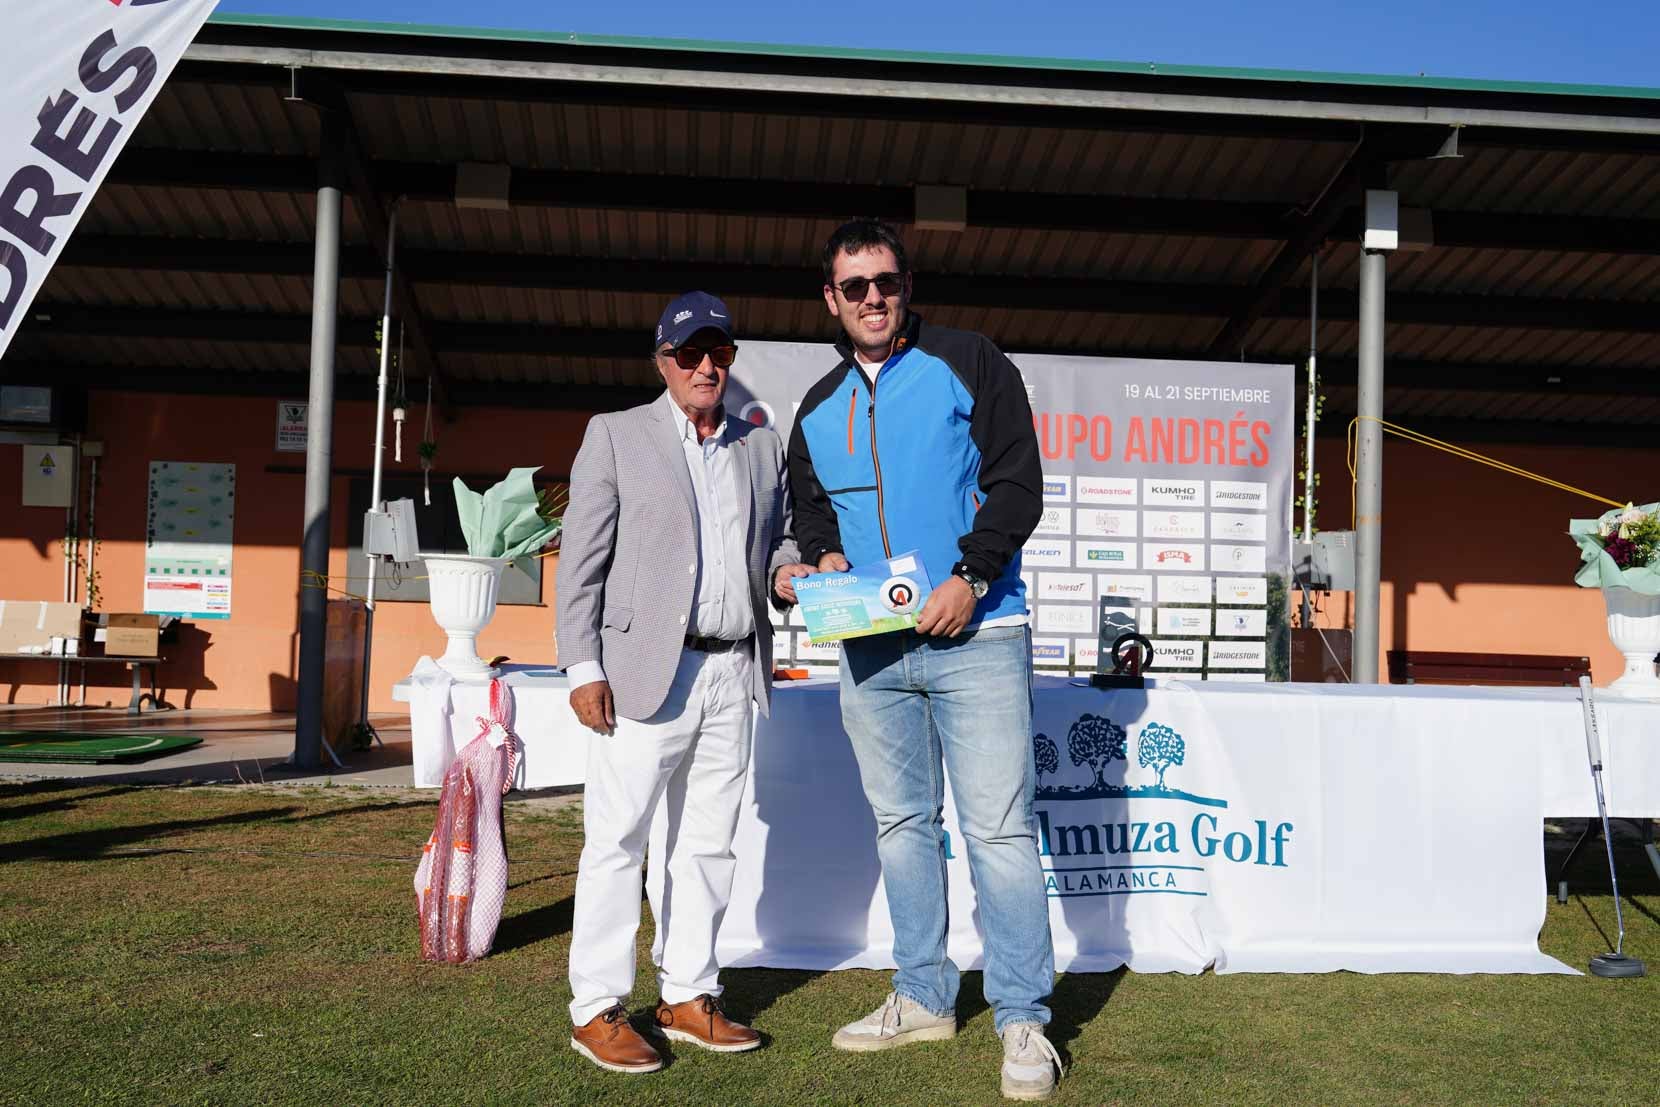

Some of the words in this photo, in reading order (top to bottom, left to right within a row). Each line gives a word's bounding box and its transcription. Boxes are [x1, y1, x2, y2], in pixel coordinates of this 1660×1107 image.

[0, 28, 158, 332] DRÉS
[1124, 384, 1139, 398] 19
[1144, 386, 1162, 399] AL
[1166, 385, 1180, 400] 21
[1184, 387, 1271, 403] SEPTIEMBRE
[1034, 413, 1112, 463] UPO
[1123, 411, 1272, 468] ANDRÉS
[1151, 487, 1196, 495] KUMHO
[1216, 491, 1261, 501] BRIDGESTONE
[796, 580, 821, 591] Bono
[825, 575, 858, 587] Regalo
[811, 641, 841, 649] Hank
[1213, 652, 1260, 660] BRIDGESTONE
[1036, 811, 1180, 856] lmuza
[1191, 812, 1294, 867] Golf
[1046, 871, 1178, 892] ALAMANCA
